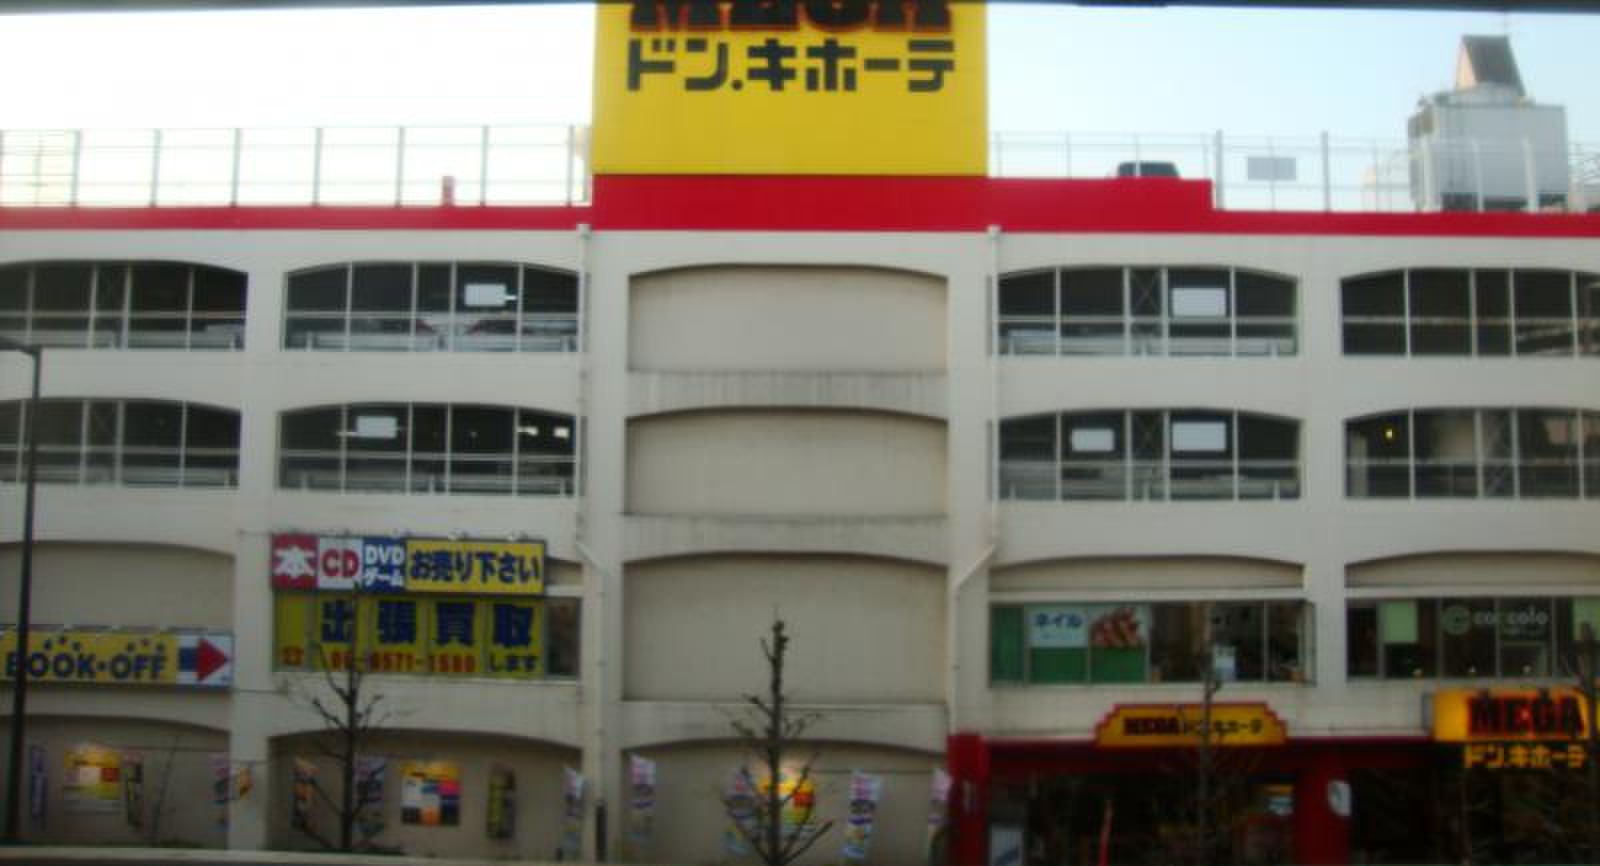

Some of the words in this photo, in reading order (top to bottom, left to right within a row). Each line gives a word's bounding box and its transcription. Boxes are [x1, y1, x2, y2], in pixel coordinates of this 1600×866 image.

[273, 547, 316, 580] 本
[321, 548, 360, 579] CD
[364, 545, 405, 565] DVD
[410, 550, 541, 584] お売り下さい
[364, 567, 405, 587] ゲーム
[489, 652, 537, 673] します
[1467, 691, 1585, 737] MEGA
